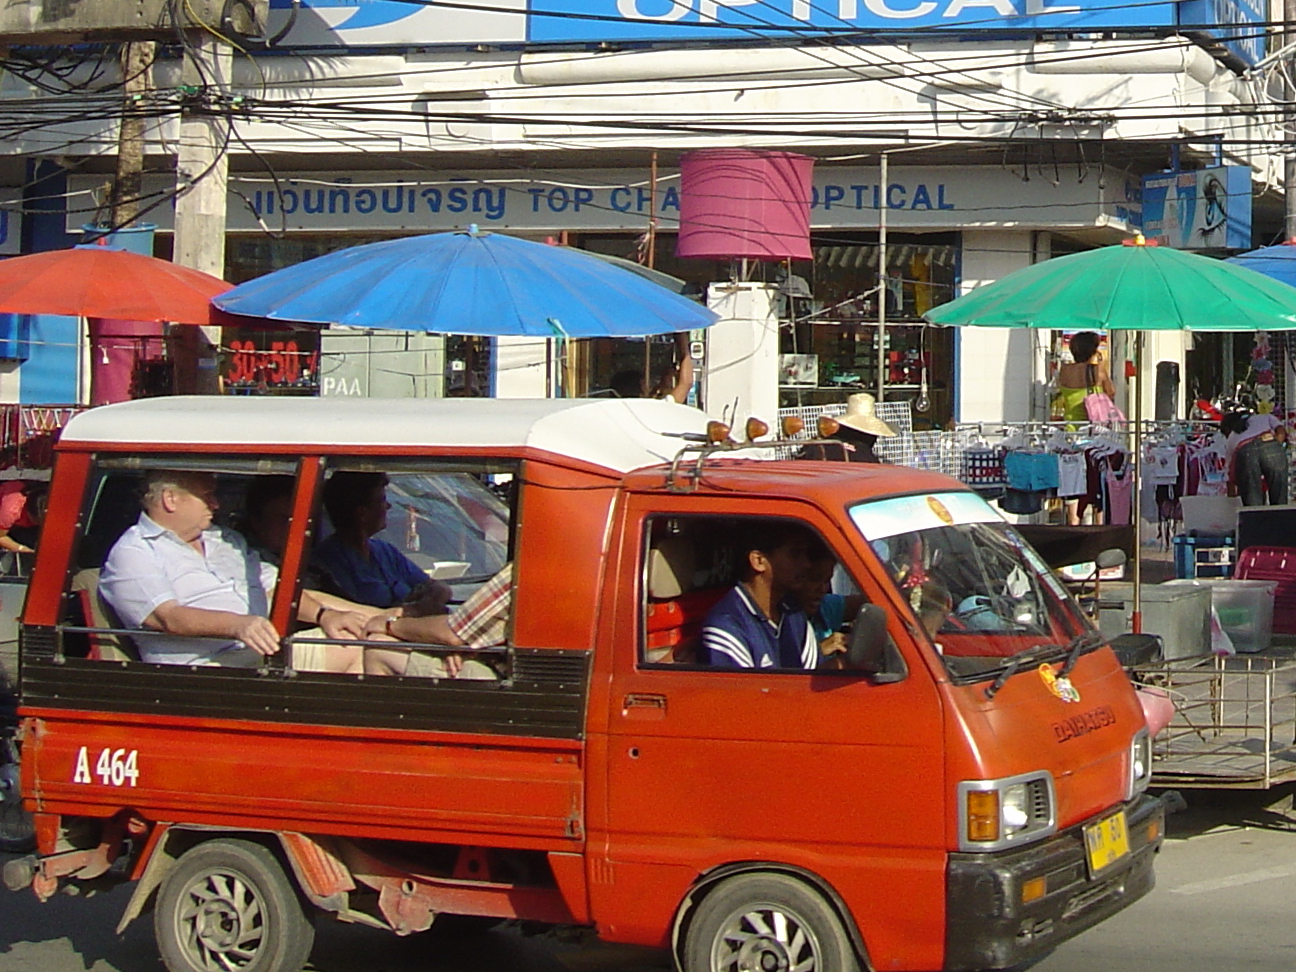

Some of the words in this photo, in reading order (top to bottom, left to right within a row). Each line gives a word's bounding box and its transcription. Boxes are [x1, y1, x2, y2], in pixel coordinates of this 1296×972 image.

[528, 187, 593, 213] TOP
[1051, 705, 1117, 744] DAIHATSU
[74, 746, 92, 784] A
[96, 747, 139, 787] 464
